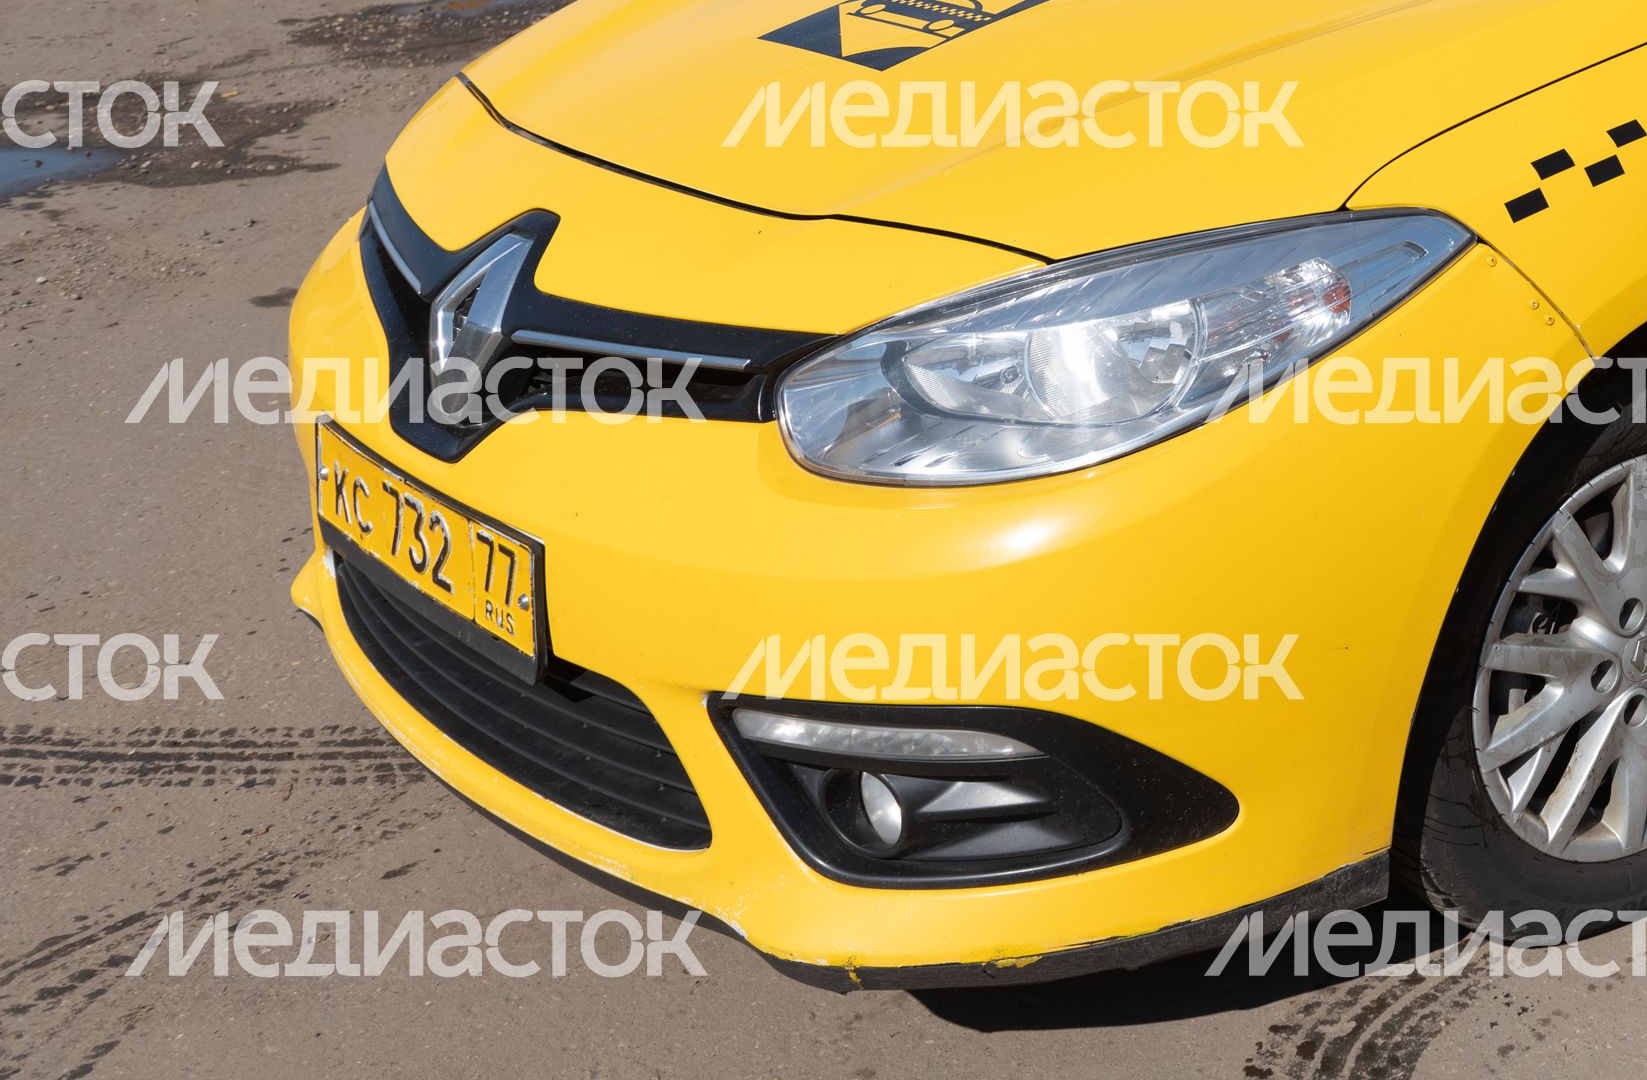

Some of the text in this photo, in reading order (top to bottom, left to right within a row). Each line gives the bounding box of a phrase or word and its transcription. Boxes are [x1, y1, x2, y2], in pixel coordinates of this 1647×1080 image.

[382, 480, 455, 596] 732
[476, 530, 518, 608] 77
[485, 599, 516, 637] RUS
